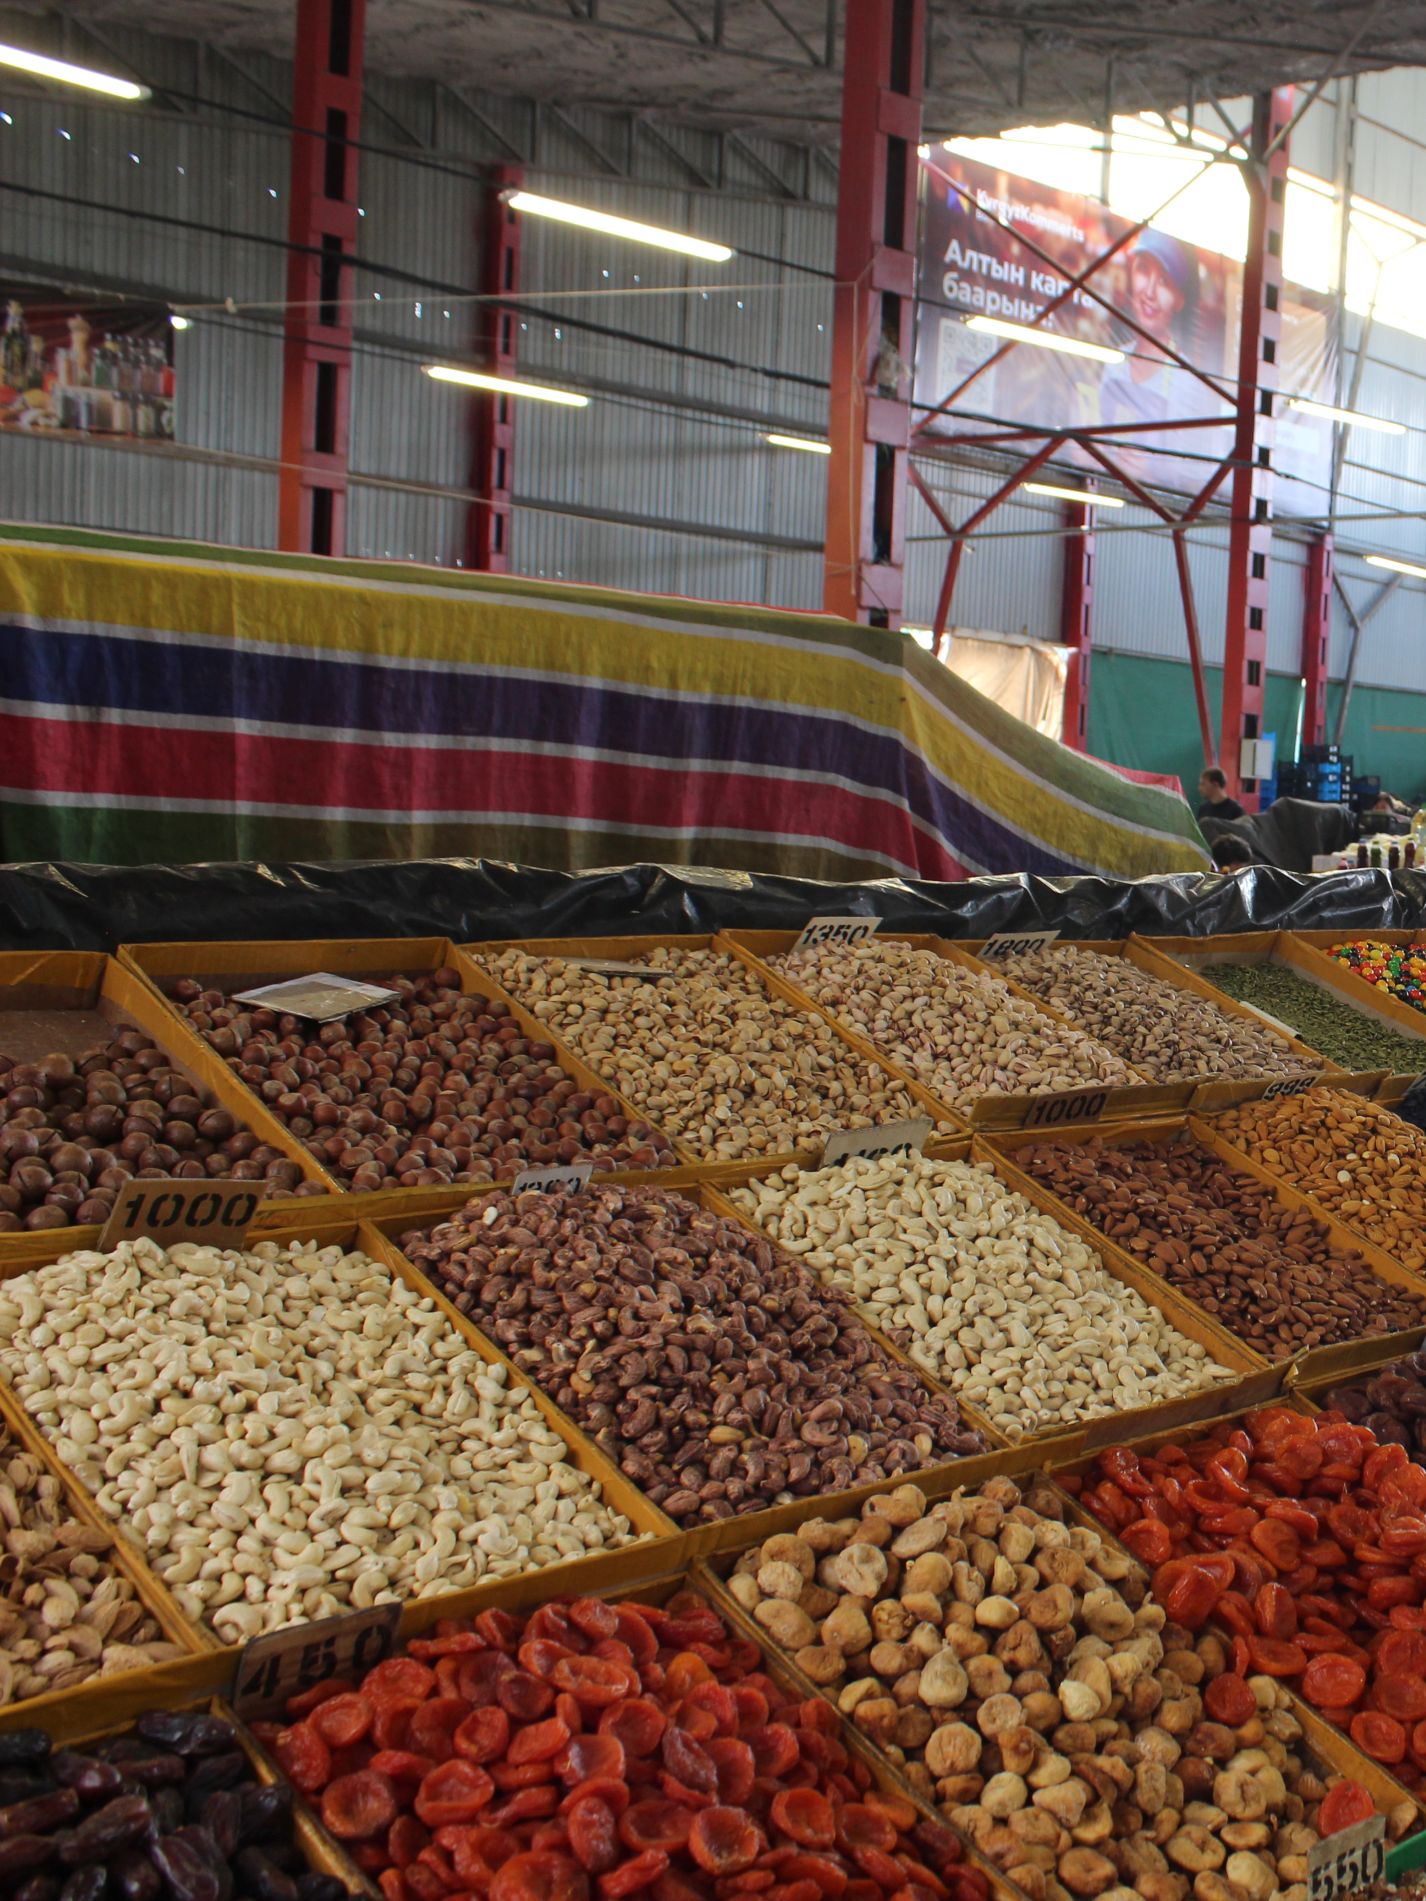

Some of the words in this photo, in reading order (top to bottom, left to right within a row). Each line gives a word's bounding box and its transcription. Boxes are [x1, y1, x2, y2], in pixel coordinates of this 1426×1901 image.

[943, 239, 1025, 288] Алтын
[802, 925, 869, 945] 1350
[1034, 1092, 1106, 1124] 1000
[124, 1193, 259, 1229] 1000
[240, 1625, 392, 1698] 450
[1312, 1838, 1383, 1901] 550
